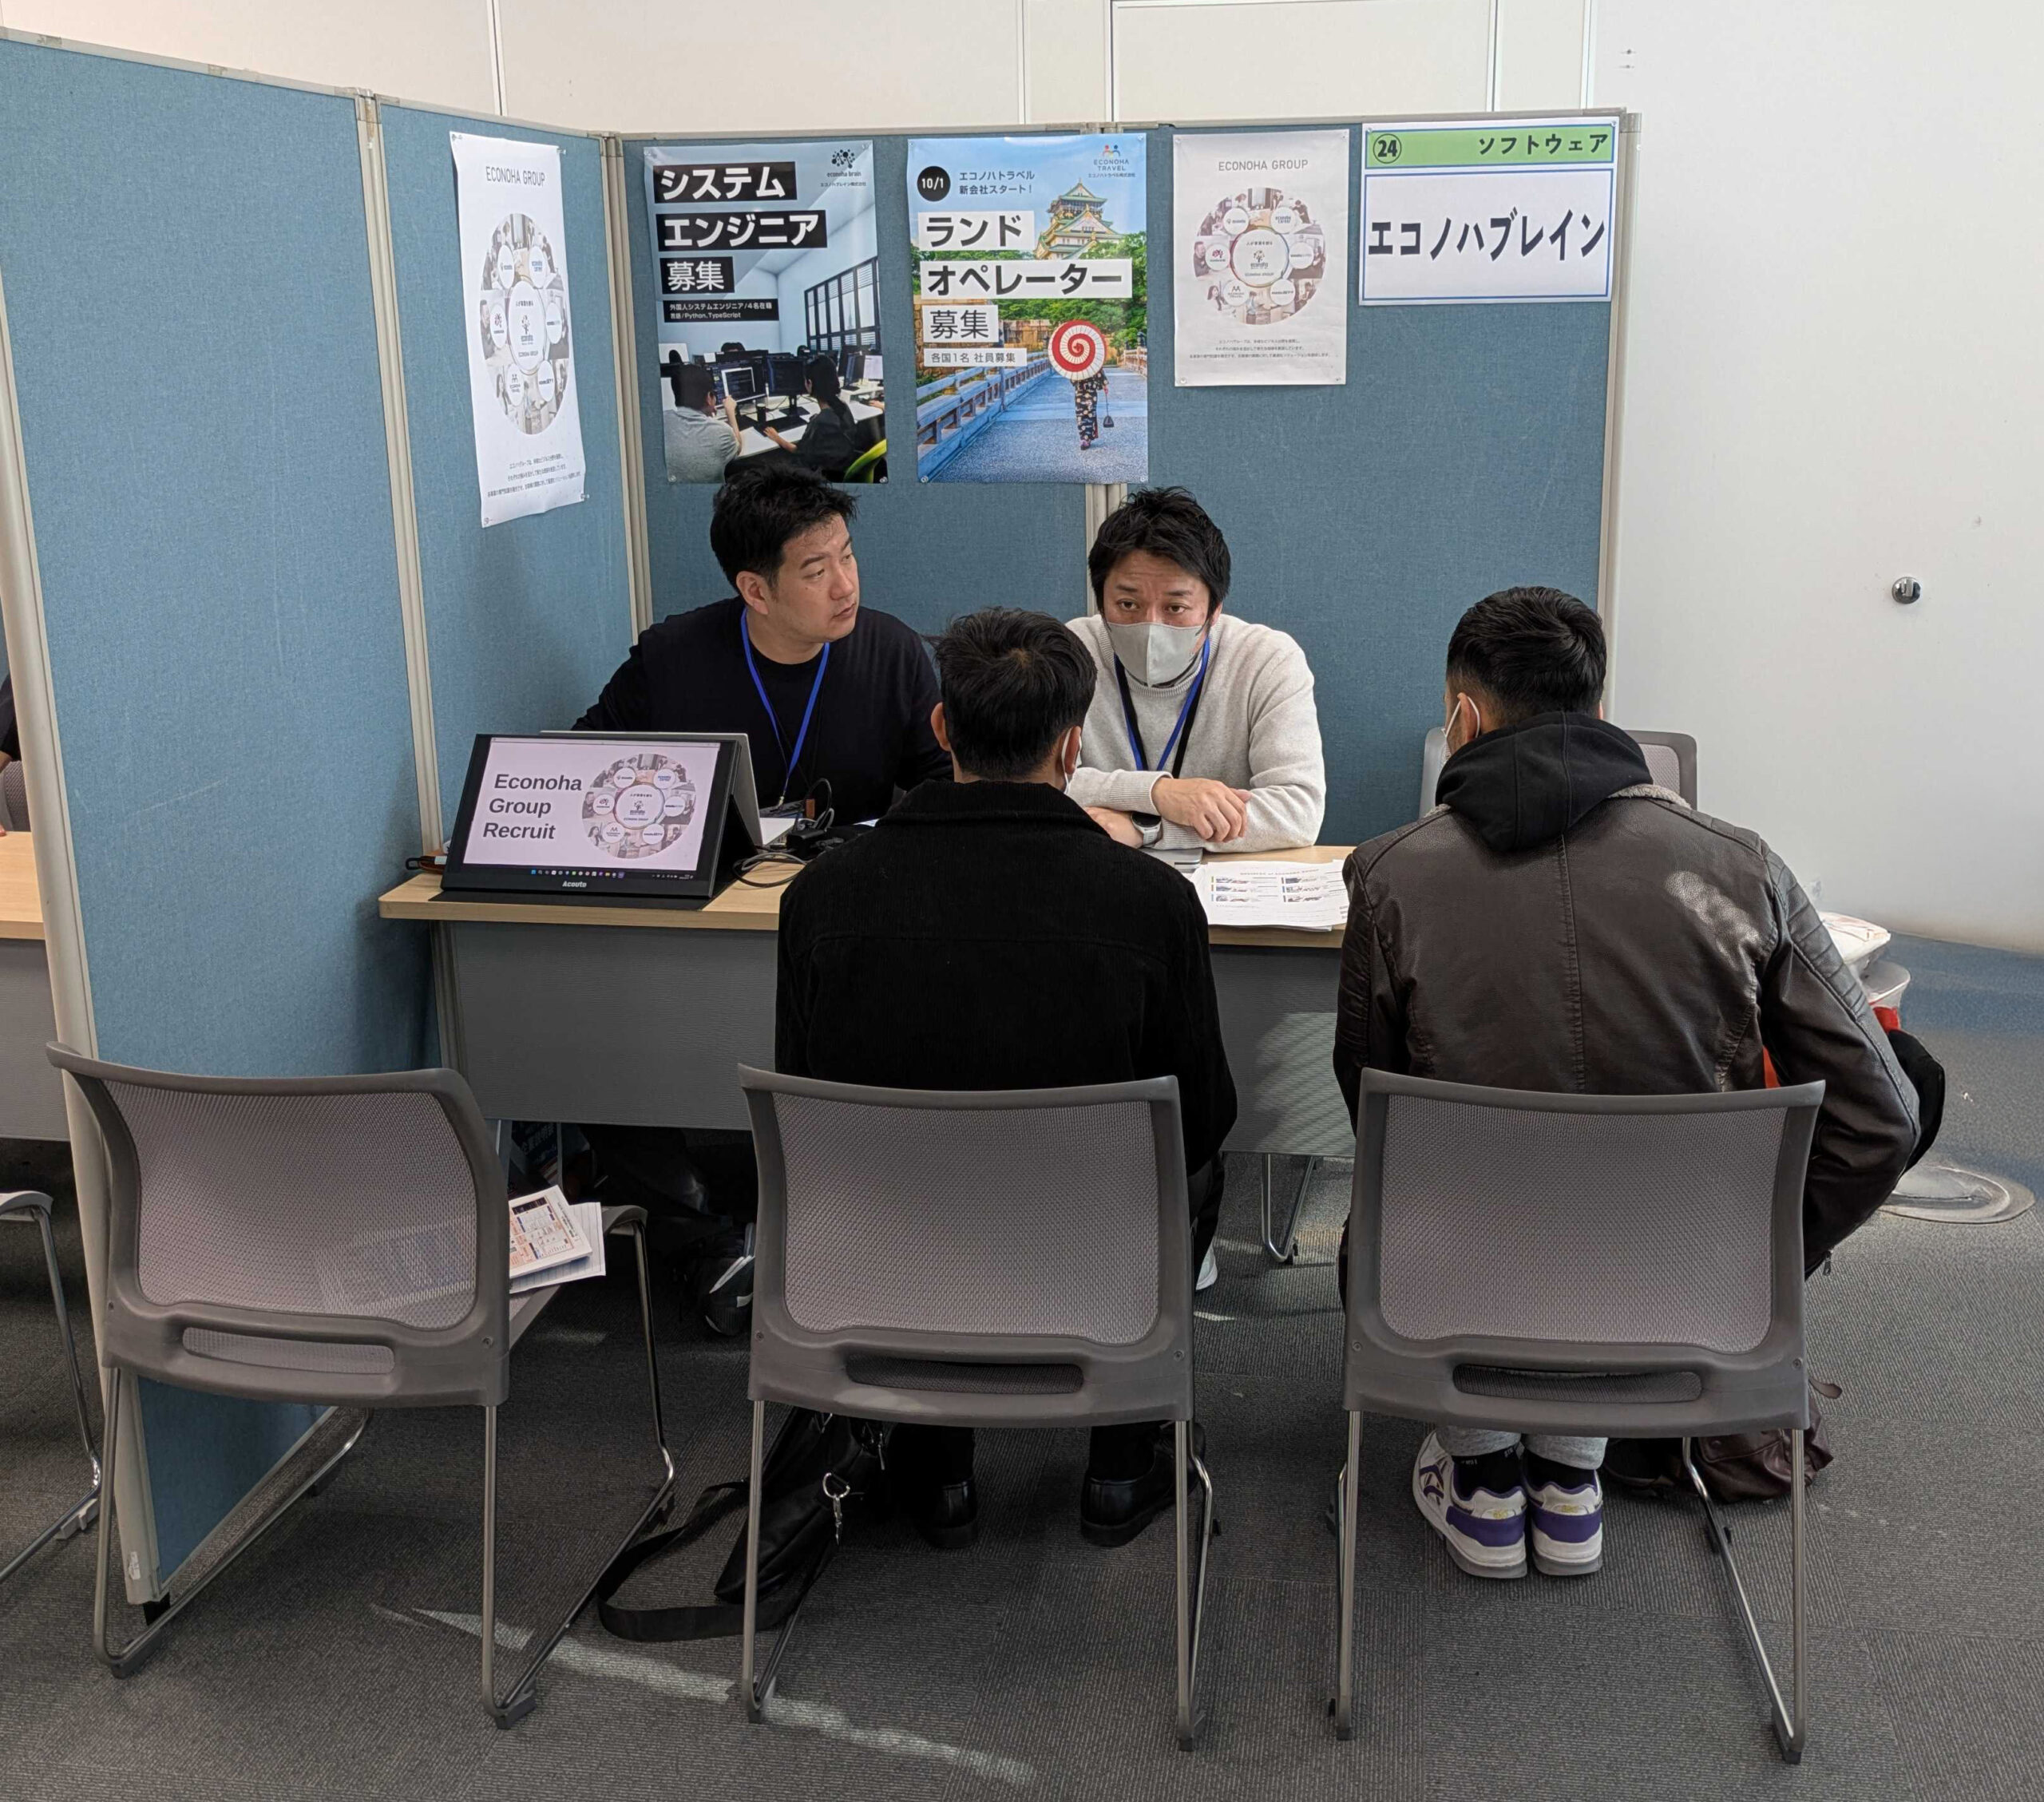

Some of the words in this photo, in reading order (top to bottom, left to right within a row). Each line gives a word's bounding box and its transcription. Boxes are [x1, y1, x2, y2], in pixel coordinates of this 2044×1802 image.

[1477, 133, 1609, 156] ソフトウェア
[959, 171, 1036, 180] エコノハトラベル
[1218, 160, 1268, 172] ECONOHA
[1271, 159, 1309, 171] GROUP
[485, 166, 521, 184] ECONOHA
[523, 170, 546, 187] GROUP
[660, 166, 786, 200] システム
[921, 176, 944, 189] 10/1
[959, 184, 1032, 195] 新会社スタート！
[664, 213, 819, 248] エンジニア
[926, 215, 1023, 248] ランド
[1368, 205, 1606, 262] エコノハブレイン
[667, 261, 725, 291] 募集
[927, 263, 1123, 295] オペレーター
[929, 309, 989, 339] 募集
[973, 353, 1016, 363] 社員募集
[494, 773, 582, 791] Econoha
[489, 798, 552, 818] Group
[482, 822, 556, 840] Recruit
